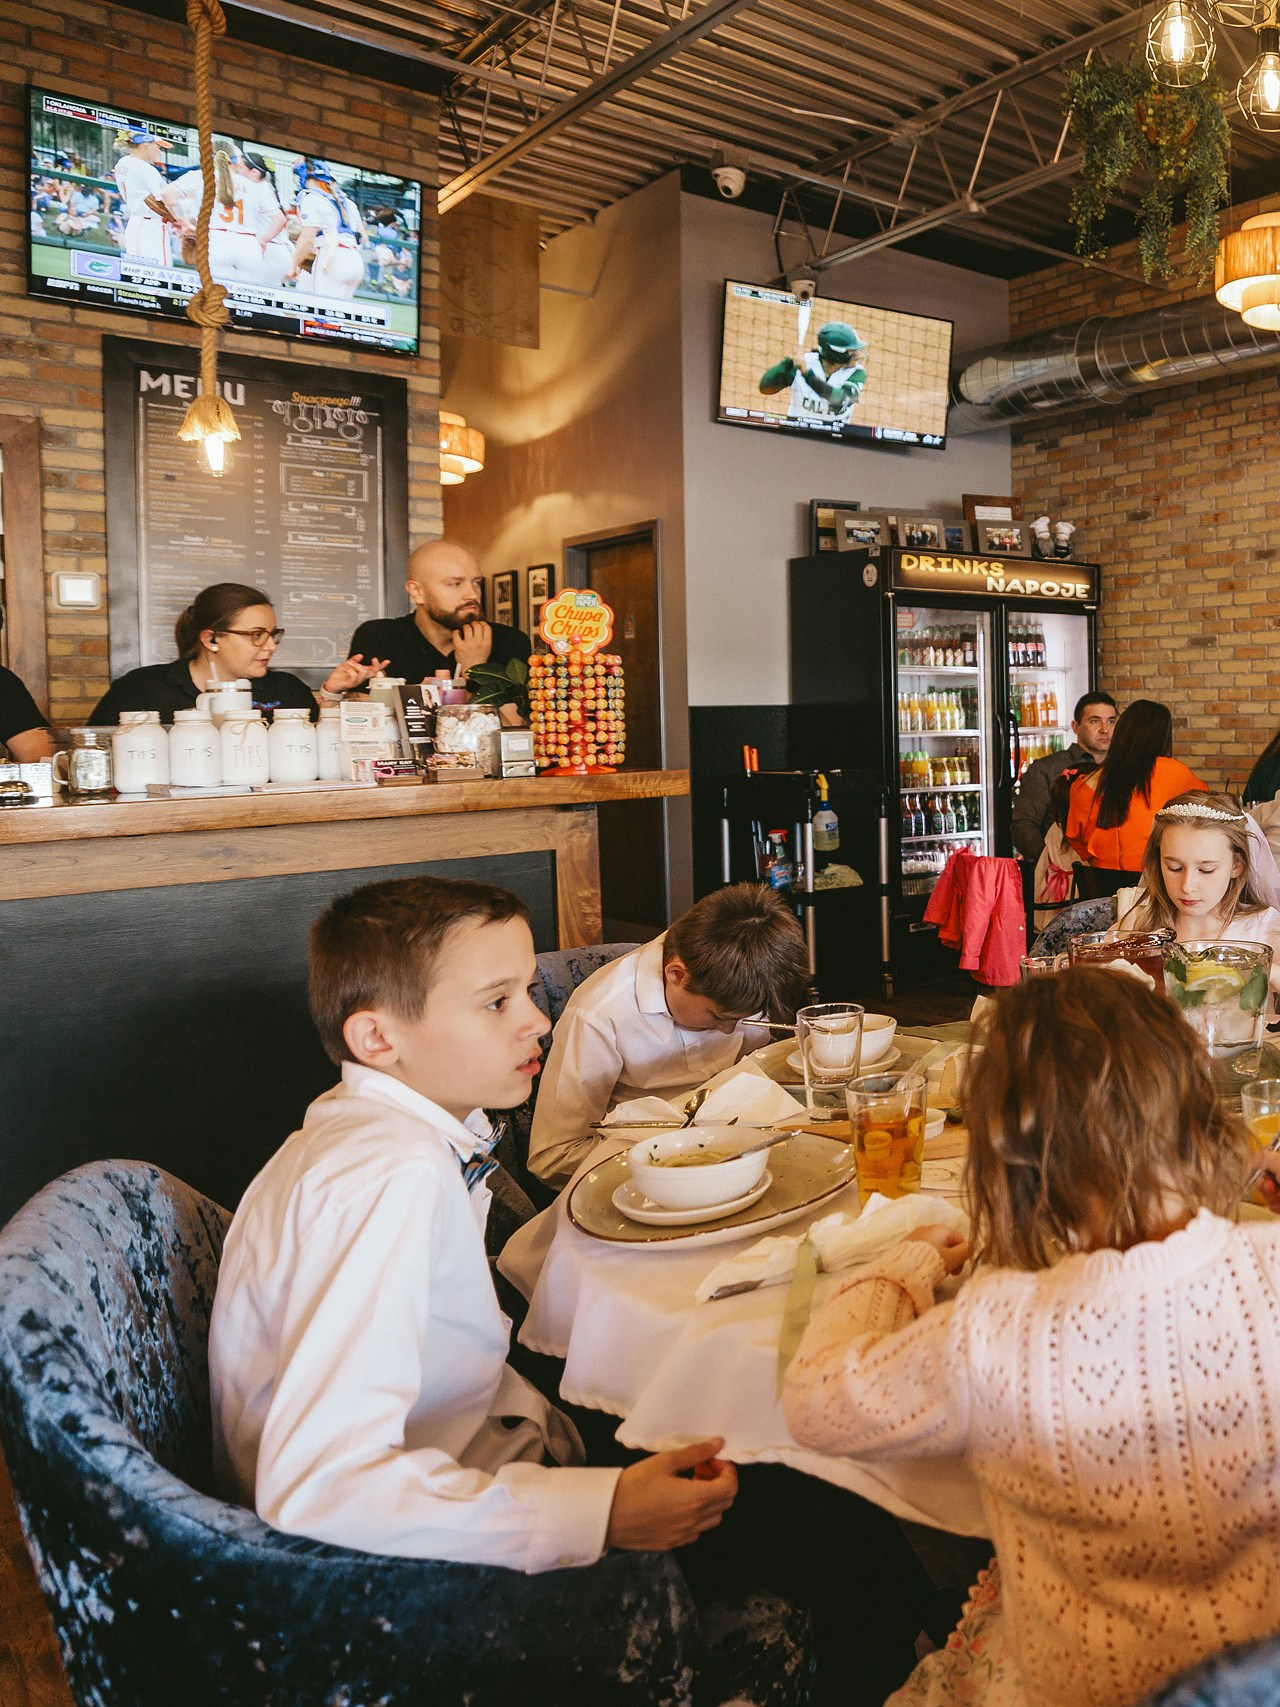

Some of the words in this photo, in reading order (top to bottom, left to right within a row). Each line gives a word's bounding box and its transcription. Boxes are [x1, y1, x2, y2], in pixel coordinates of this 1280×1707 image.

[50, 100, 88, 114] OKLAHOMA
[102, 112, 129, 124] FLORIDA
[900, 554, 1005, 577] DRINKS
[986, 576, 1091, 598] NAPOJE
[554, 604, 603, 624] Chupa
[550, 620, 599, 638] Chups
